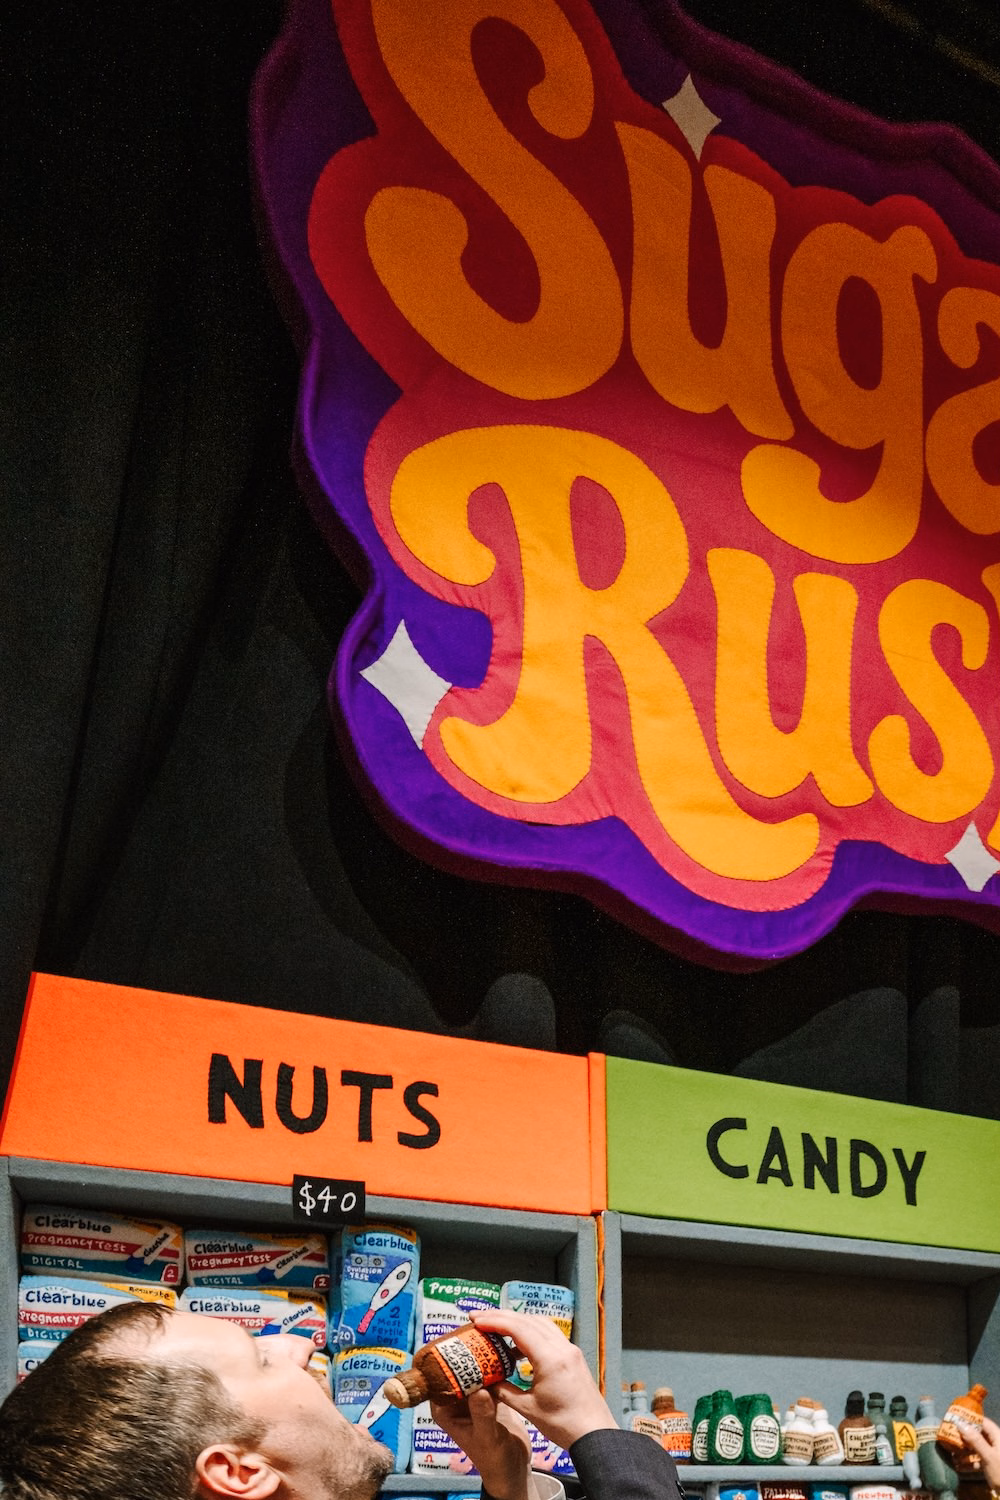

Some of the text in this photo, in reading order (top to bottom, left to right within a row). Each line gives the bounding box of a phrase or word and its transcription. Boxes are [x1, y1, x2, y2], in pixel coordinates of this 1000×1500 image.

[207, 1053, 442, 1149] NUTS
[706, 1117, 926, 1206] CANDY
[299, 1181, 357, 1216] $40
[35, 1215, 112, 1233] Clearblue
[27, 1234, 126, 1252] Pregnancy Test
[144, 1232, 170, 1258] Clearblue
[194, 1242, 254, 1255] Clearblue
[354, 1234, 414, 1252] Clearblue
[32, 1256, 84, 1269] DIGITAL
[191, 1254, 271, 1267] Pregnancy Test
[201, 1276, 244, 1285] DIGITAL
[428, 1282, 500, 1300] Pregnacare
[522, 1291, 562, 1301] FOR MEN
[25, 1290, 107, 1308] Clearblue
[189, 1300, 261, 1313] Clearblue
[19, 1311, 76, 1326] Pregnancy
[282, 1305, 313, 1326] Clearblue
[390, 1307, 400, 1319] 2
[427, 1313, 456, 1321] EXPERT
[524, 1307, 567, 1318] FERTILITY
[342, 1358, 402, 1373] Clearblue
[416, 1431, 448, 1441] fertility
